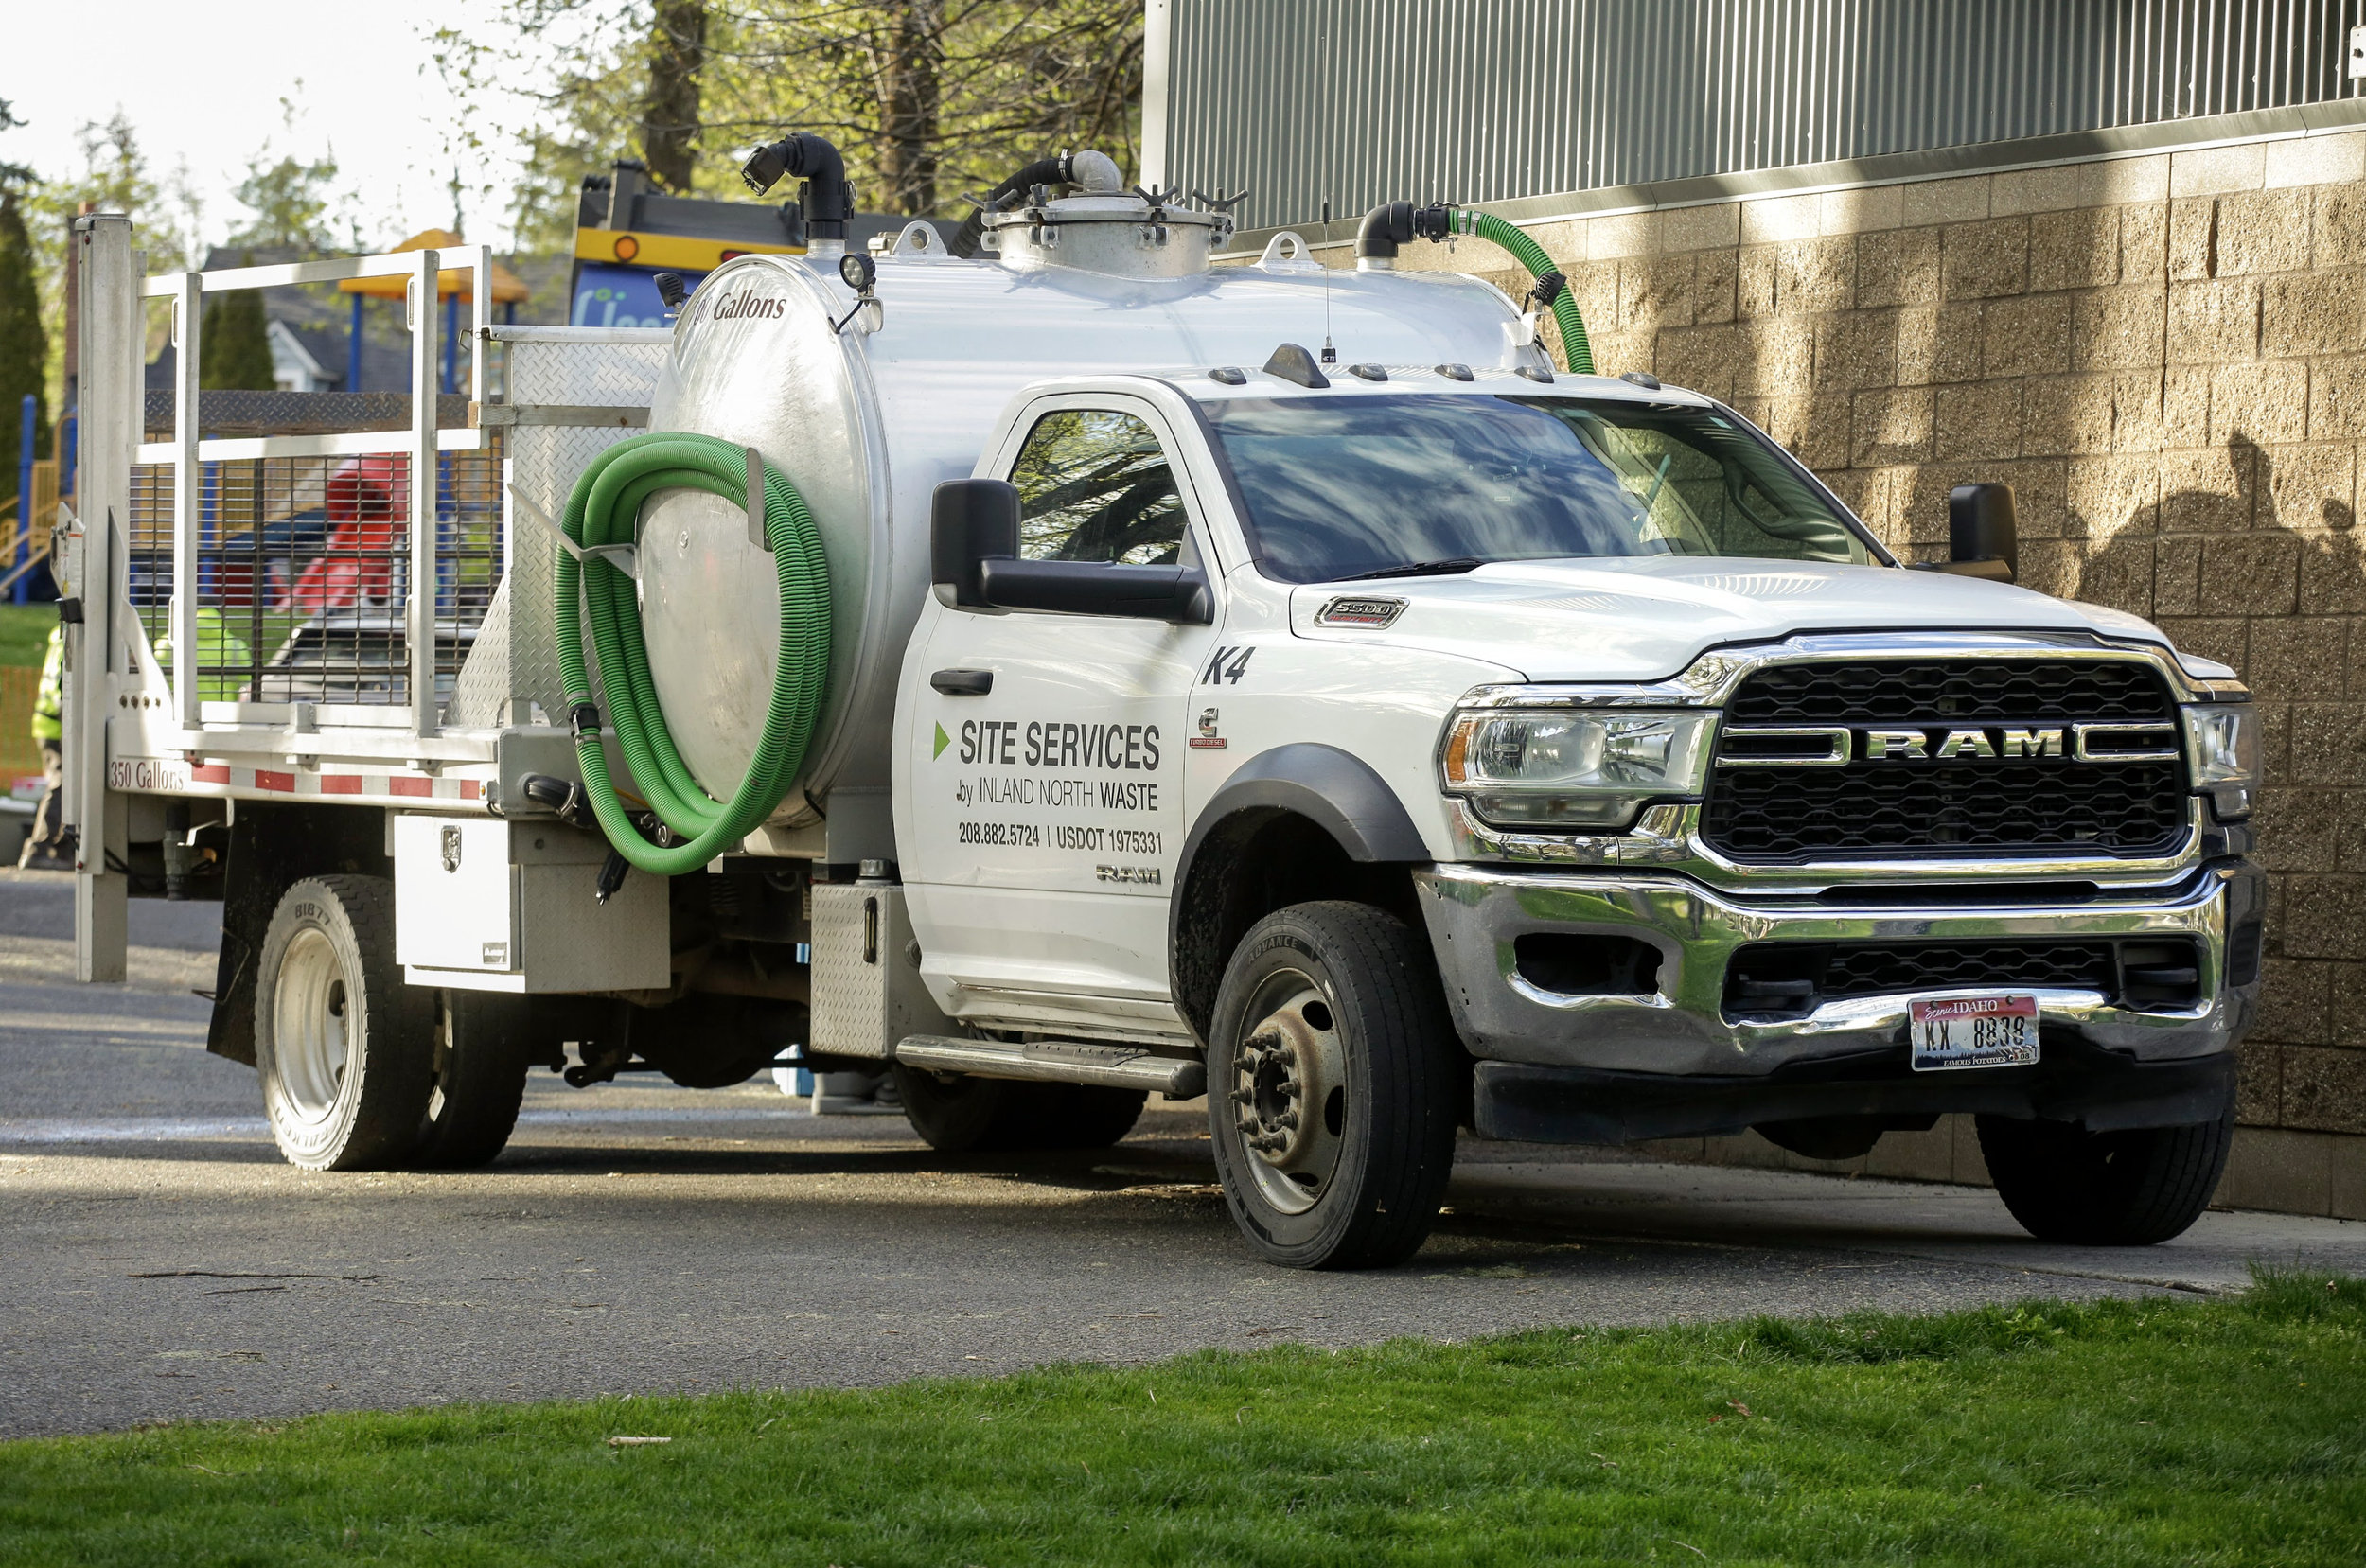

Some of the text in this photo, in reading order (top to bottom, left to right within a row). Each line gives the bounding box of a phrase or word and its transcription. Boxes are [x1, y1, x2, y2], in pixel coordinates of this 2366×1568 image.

[713, 290, 786, 320] Gallons
[1336, 604, 1391, 614] 5500
[1201, 646, 1256, 684] K4
[960, 719, 1160, 770] SITE SERVICES
[1868, 729, 2063, 758] RAM
[111, 761, 184, 790] 350 Gallons
[959, 777, 1158, 811] by INLAND NORTH WASTE
[959, 821, 1162, 854] 208.882.5724 USDOT 1975331
[1096, 863, 1162, 885] RAM
[1248, 935, 1298, 965] ADVANCE
[1925, 999, 1998, 1019] Scenic IDAHO
[1924, 1015, 2026, 1051] KX 8838
[1972, 1055, 2006, 1065] POTATOES
